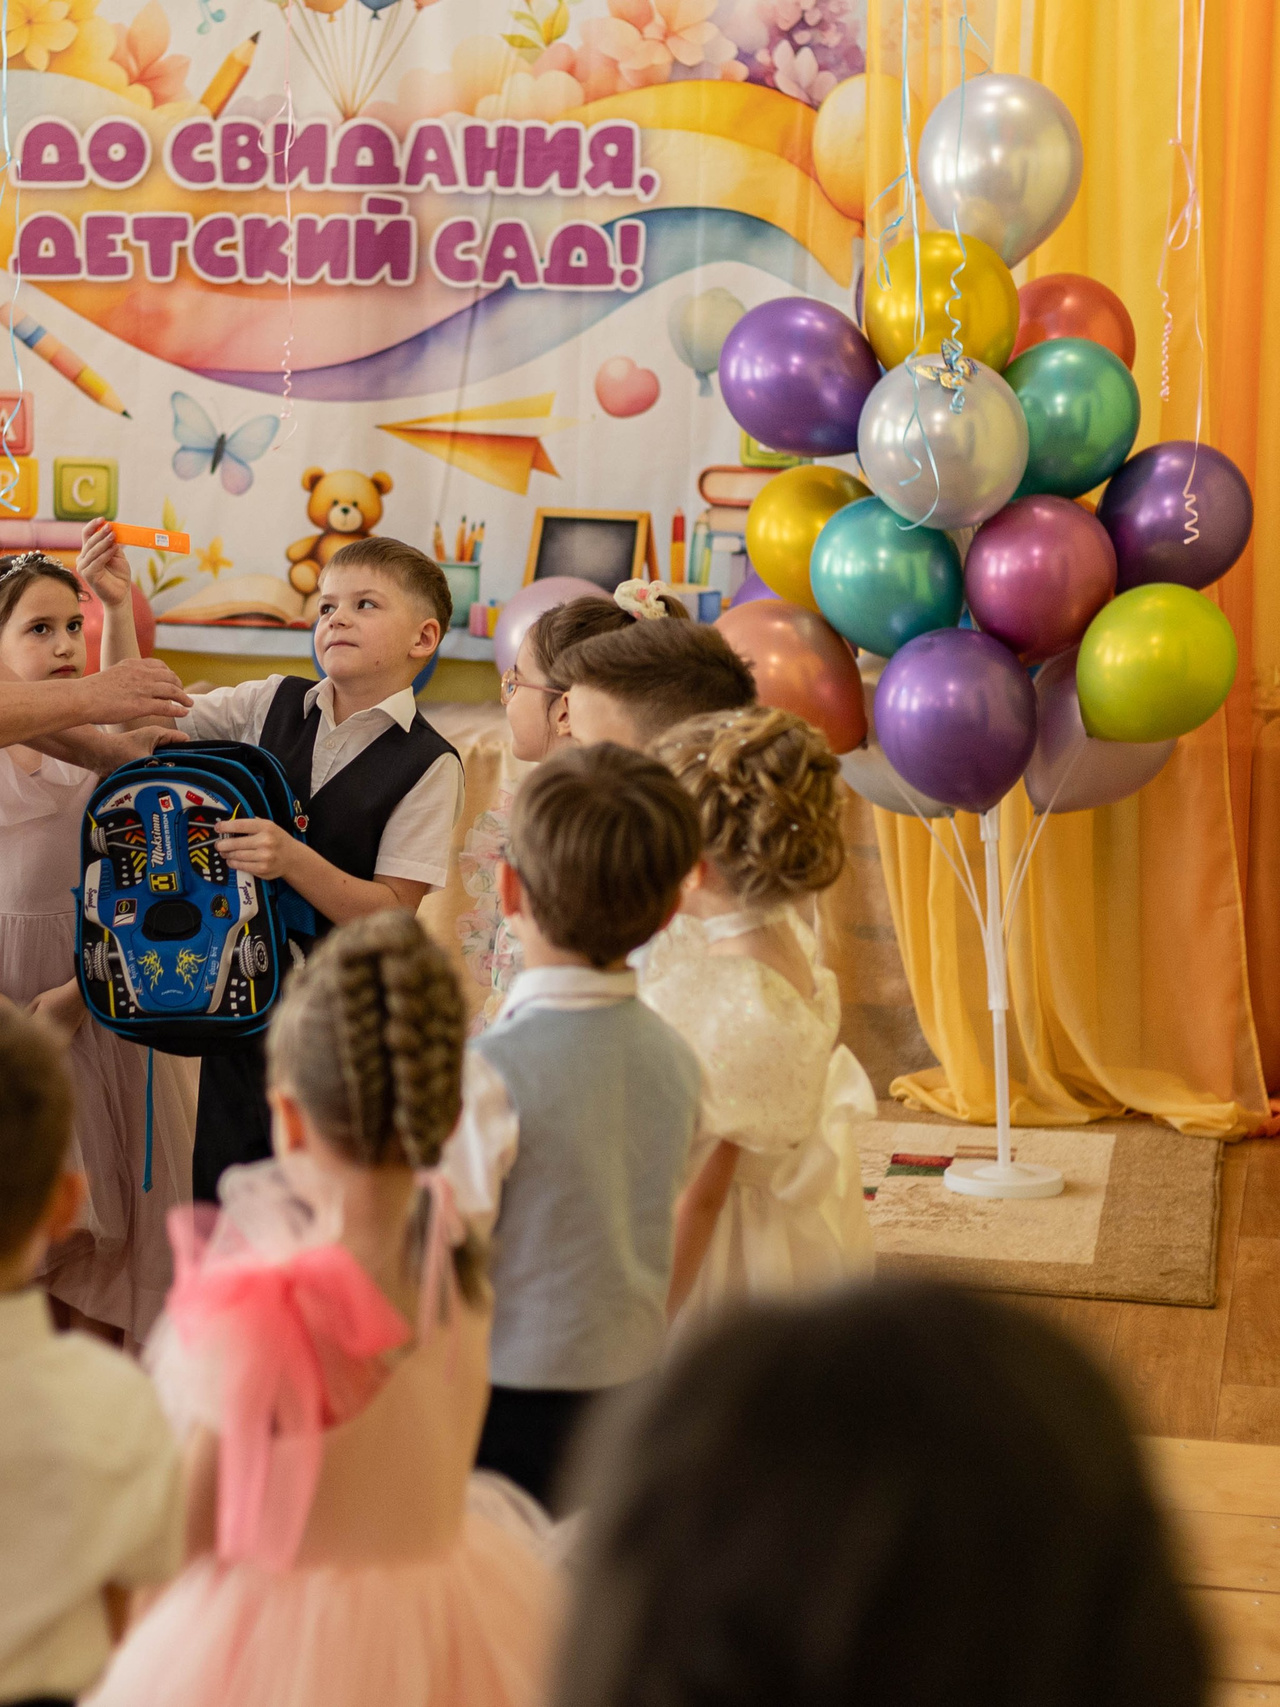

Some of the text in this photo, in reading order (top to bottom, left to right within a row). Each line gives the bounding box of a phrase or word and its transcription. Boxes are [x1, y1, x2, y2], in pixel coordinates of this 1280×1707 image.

[18, 121, 656, 196] ДО СВИДАНИЯ,
[16, 197, 641, 287] ДЕТСКИЙ САД!
[72, 475, 96, 507] C
